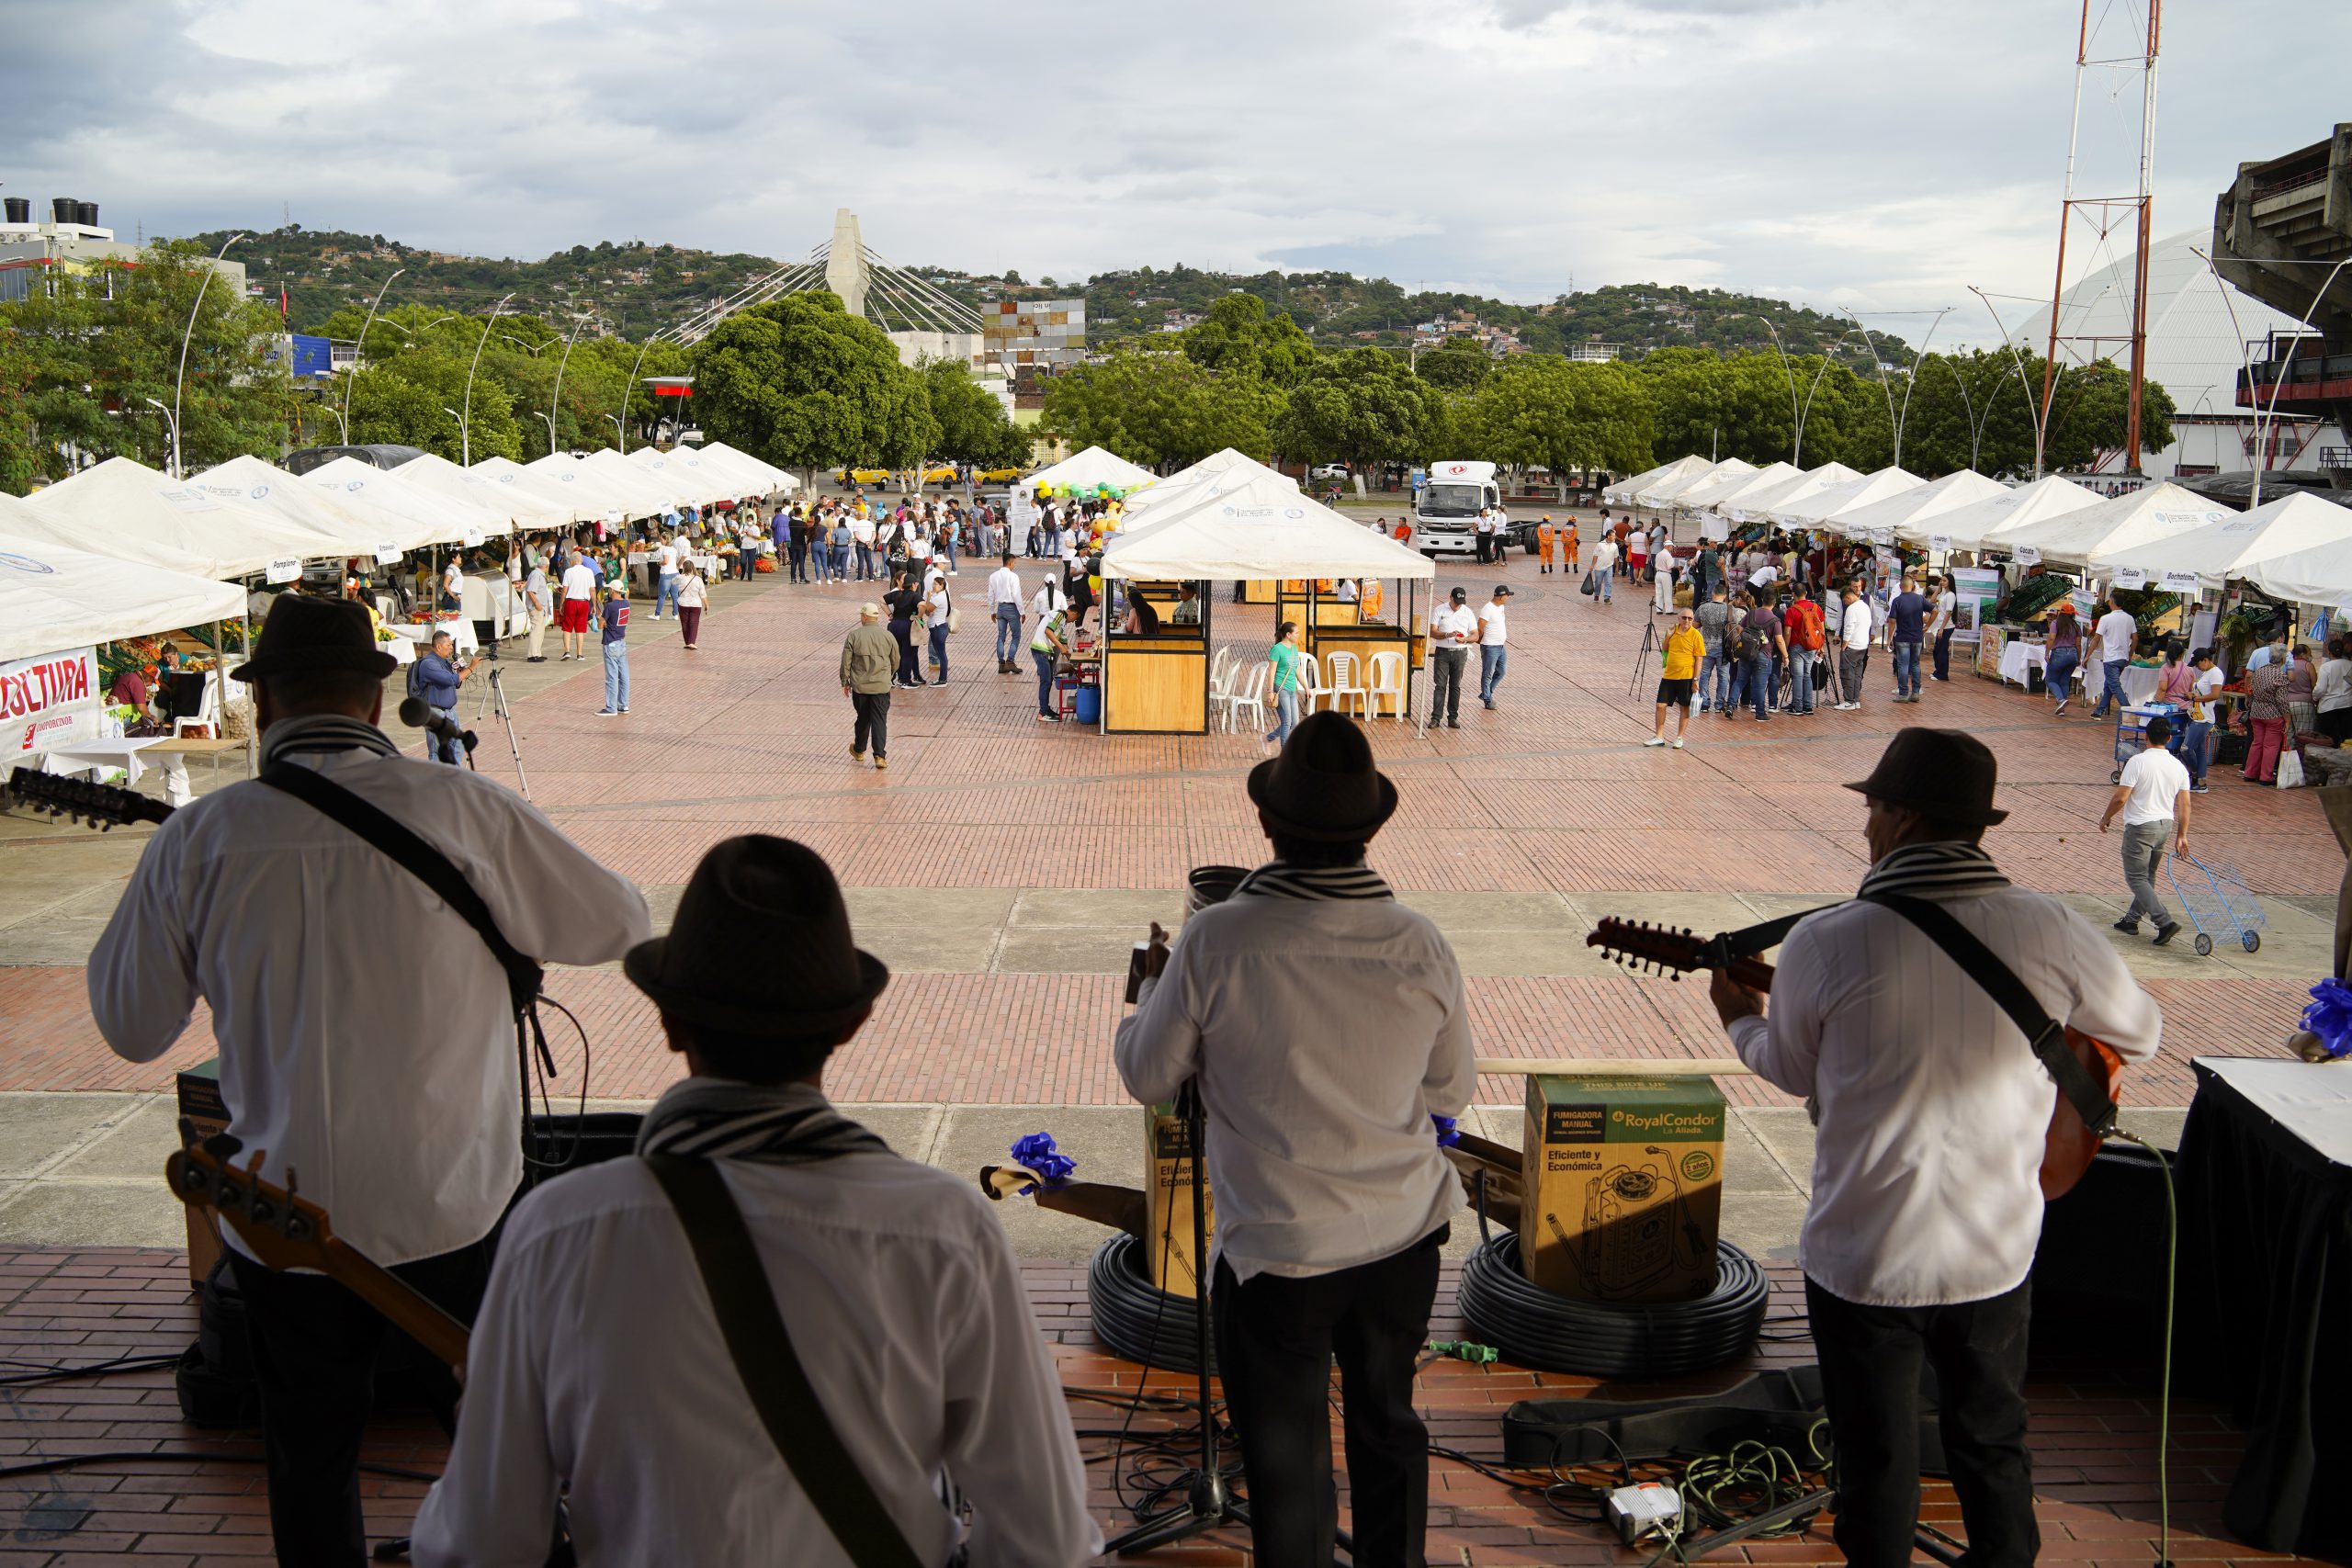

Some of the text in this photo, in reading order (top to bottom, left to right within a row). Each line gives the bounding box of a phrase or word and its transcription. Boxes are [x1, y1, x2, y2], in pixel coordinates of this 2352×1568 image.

[1553, 1111, 1602, 1119] FUMIGADORA
[1625, 1112, 1716, 1130] RoyalCondor
[1548, 1150, 1600, 1160] Eficiente y
[1547, 1161, 1602, 1172] Económica
[1692, 1160, 1709, 1170] años
